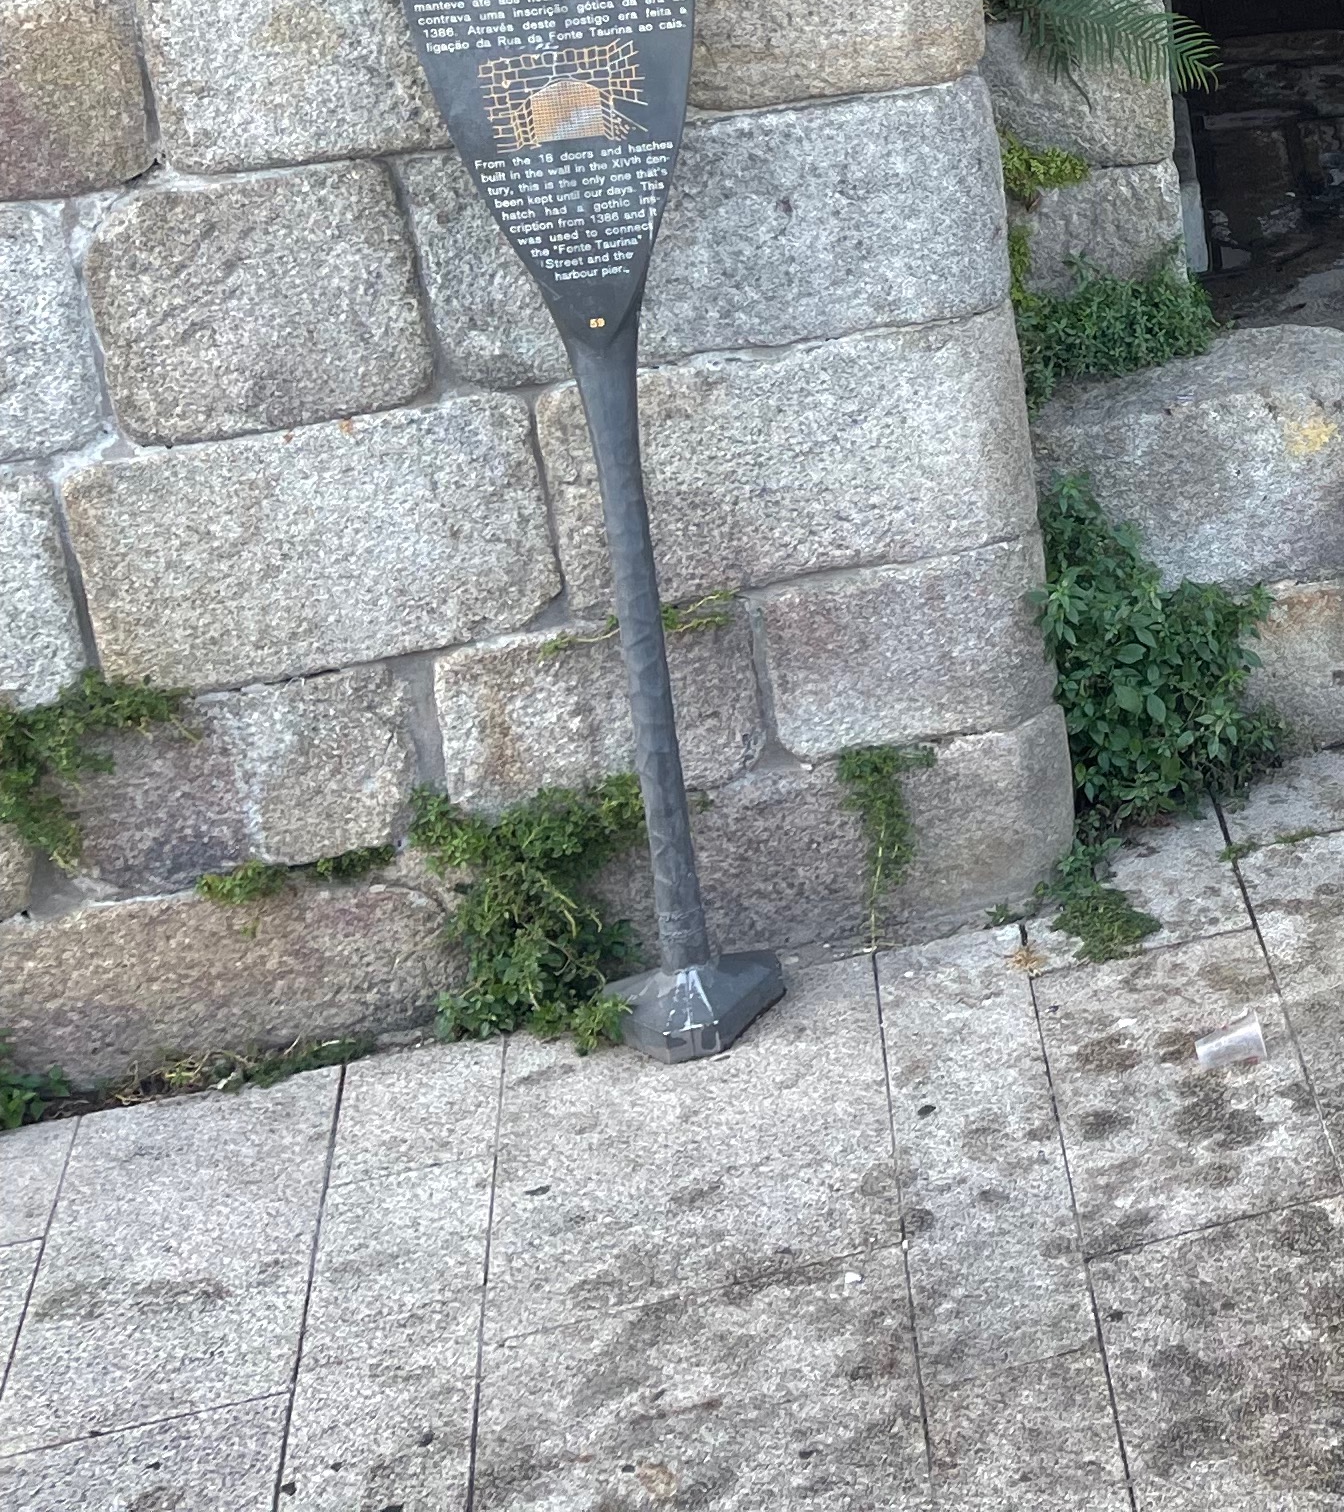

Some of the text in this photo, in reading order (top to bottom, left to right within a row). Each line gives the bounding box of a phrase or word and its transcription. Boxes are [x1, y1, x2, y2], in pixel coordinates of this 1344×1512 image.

[414, 0, 465, 12] manteve
[418, 13, 471, 26] contrava
[480, 11, 505, 21] uma
[513, 4, 568, 18] inscrição
[577, 0, 614, 13] gótica
[468, 24, 514, 35] Através
[522, 20, 556, 30] deste
[564, 14, 609, 28] postigo
[618, 12, 638, 21] era
[646, 8, 672, 18] feita
[426, 18, 686, 54] ligação da Rua da Fonte Taurina ao cais.
[474, 160, 506, 170] From
[512, 156, 531, 166] the
[560, 150, 594, 161] doors
[600, 145, 622, 157] and
[628, 141, 674, 153] hatches
[481, 155, 670, 183] built in the wall in the XIVth cen-
[518, 182, 540, 193] this
[544, 180, 554, 190] is
[559, 179, 577, 189] the
[582, 175, 605, 186] only
[610, 173, 631, 182] one
[636, 167, 668, 179] that's
[494, 180, 665, 208] been kept until our days. This
[502, 209, 535, 221] hatch
[544, 206, 567, 216] had
[594, 198, 631, 212] gothic
[639, 194, 661, 205] ins-
[510, 221, 554, 234] cription
[558, 217, 585, 228] from
[590, 212, 619, 224] 1386
[624, 209, 645, 220] and
[517, 222, 653, 246] was used to connect
[530, 248, 550, 258] the
[545, 250, 634, 269] Street and the
[555, 269, 598, 281] harbour
